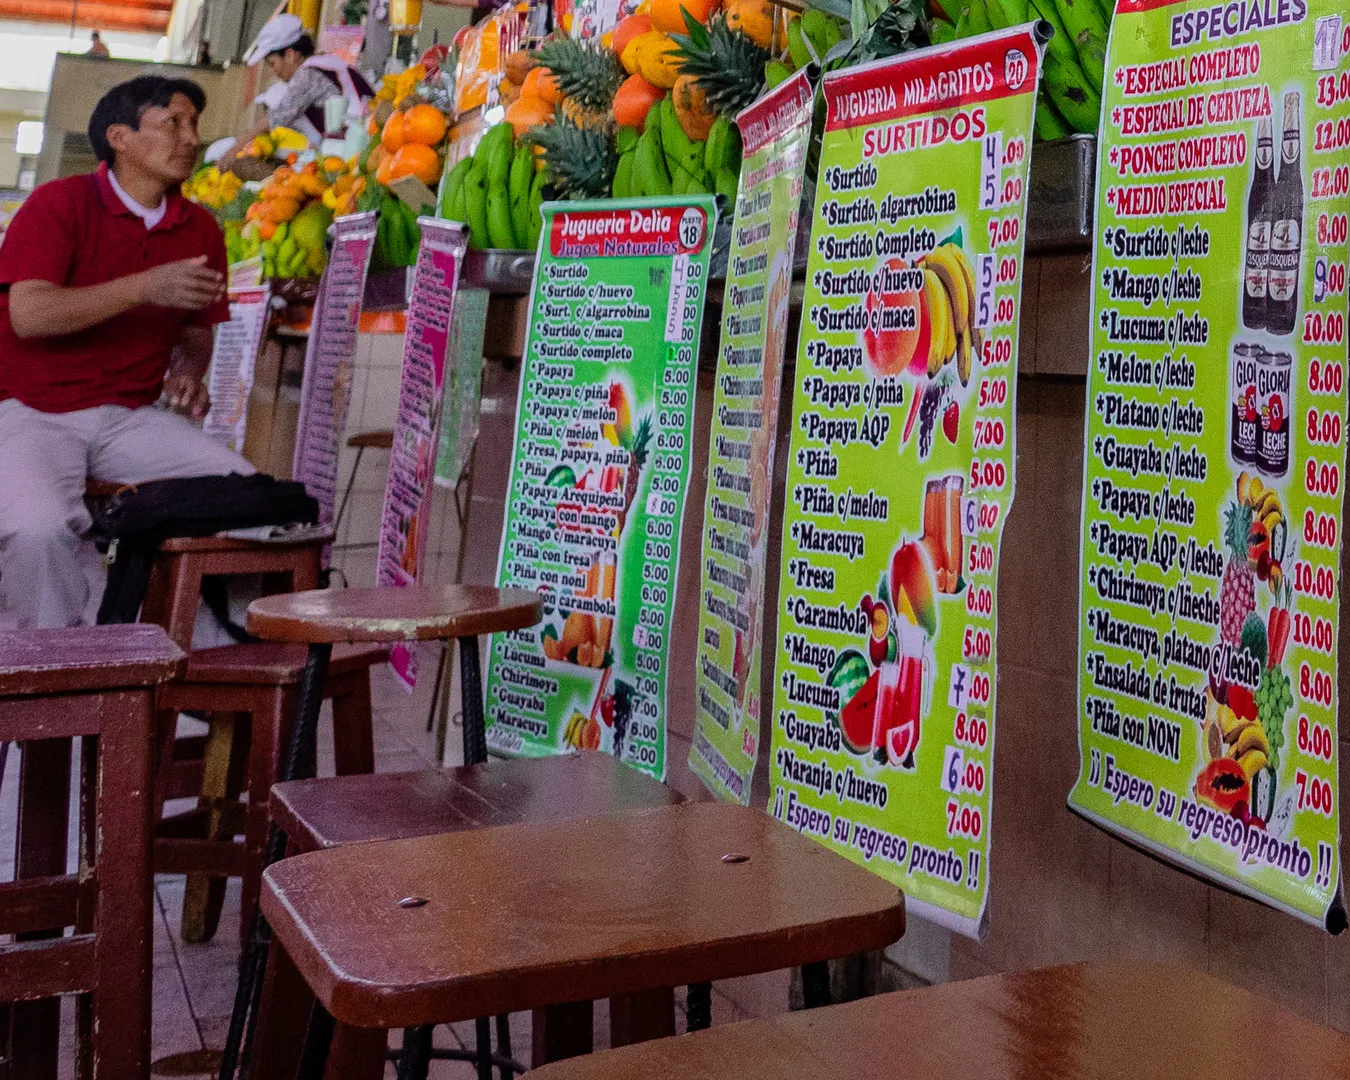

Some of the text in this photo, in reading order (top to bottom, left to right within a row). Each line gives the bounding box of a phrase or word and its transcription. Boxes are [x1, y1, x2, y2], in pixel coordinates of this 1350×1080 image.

[1008, 60, 1024, 86] 20
[1125, 59, 1186, 94] ESPECIAL
[1190, 45, 1259, 84] COMPLETO
[834, 62, 993, 122] JUGUERIA MILAGRITOS
[1122, 101, 1184, 134] ESPECIAL
[1187, 97, 1204, 125] DE
[1208, 88, 1270, 123] CERVEZA
[865, 110, 985, 156] SURTIDOS
[1120, 144, 1175, 174] PONCHE
[1180, 133, 1247, 168] COMPLETO
[1315, 120, 1350, 150] 12.00
[832, 138, 1025, 191] Surtido 4.00
[881, 188, 956, 224] algarrobina
[983, 176, 1023, 207] 5.00
[1117, 168, 1348, 215] MEDIO ESPECIAL 12.00
[630, 209, 671, 233] Delia
[683, 226, 698, 246] 18
[1114, 215, 1346, 262] Surtido c/leche 8.00
[559, 236, 678, 259] Jugos Naturales
[825, 219, 1018, 260] Surtido Completo 7.00
[550, 266, 587, 278] Surtido
[822, 260, 926, 298] Surtido c/huevo
[1112, 269, 1200, 306] Mango c/leche
[547, 285, 585, 297] Surtido
[1110, 312, 1207, 349] Lucuma c/leche
[538, 363, 573, 380] Papaya
[815, 343, 862, 372] Papaya
[536, 383, 571, 399] Papaya
[812, 378, 903, 409] Papaya c/piña
[533, 403, 569, 419] Papaya
[809, 415, 889, 446] Papaya AQP
[1262, 430, 1287, 450] LECHE
[605, 450, 629, 466] piña
[806, 450, 837, 476] Piña
[522, 482, 623, 508] Papaya Arequipeña
[803, 487, 887, 521] Piña c/melon
[1099, 524, 1223, 577] Papaya AQP c/leche
[797, 561, 834, 590] Fresa
[1098, 568, 1165, 609] Chirimoya
[795, 599, 866, 634] Carambola
[792, 636, 835, 673] Mango
[1163, 630, 1210, 671] platano
[1213, 644, 1259, 692] c/leche
[1104, 768, 1310, 876] Espero su regreso pronto
